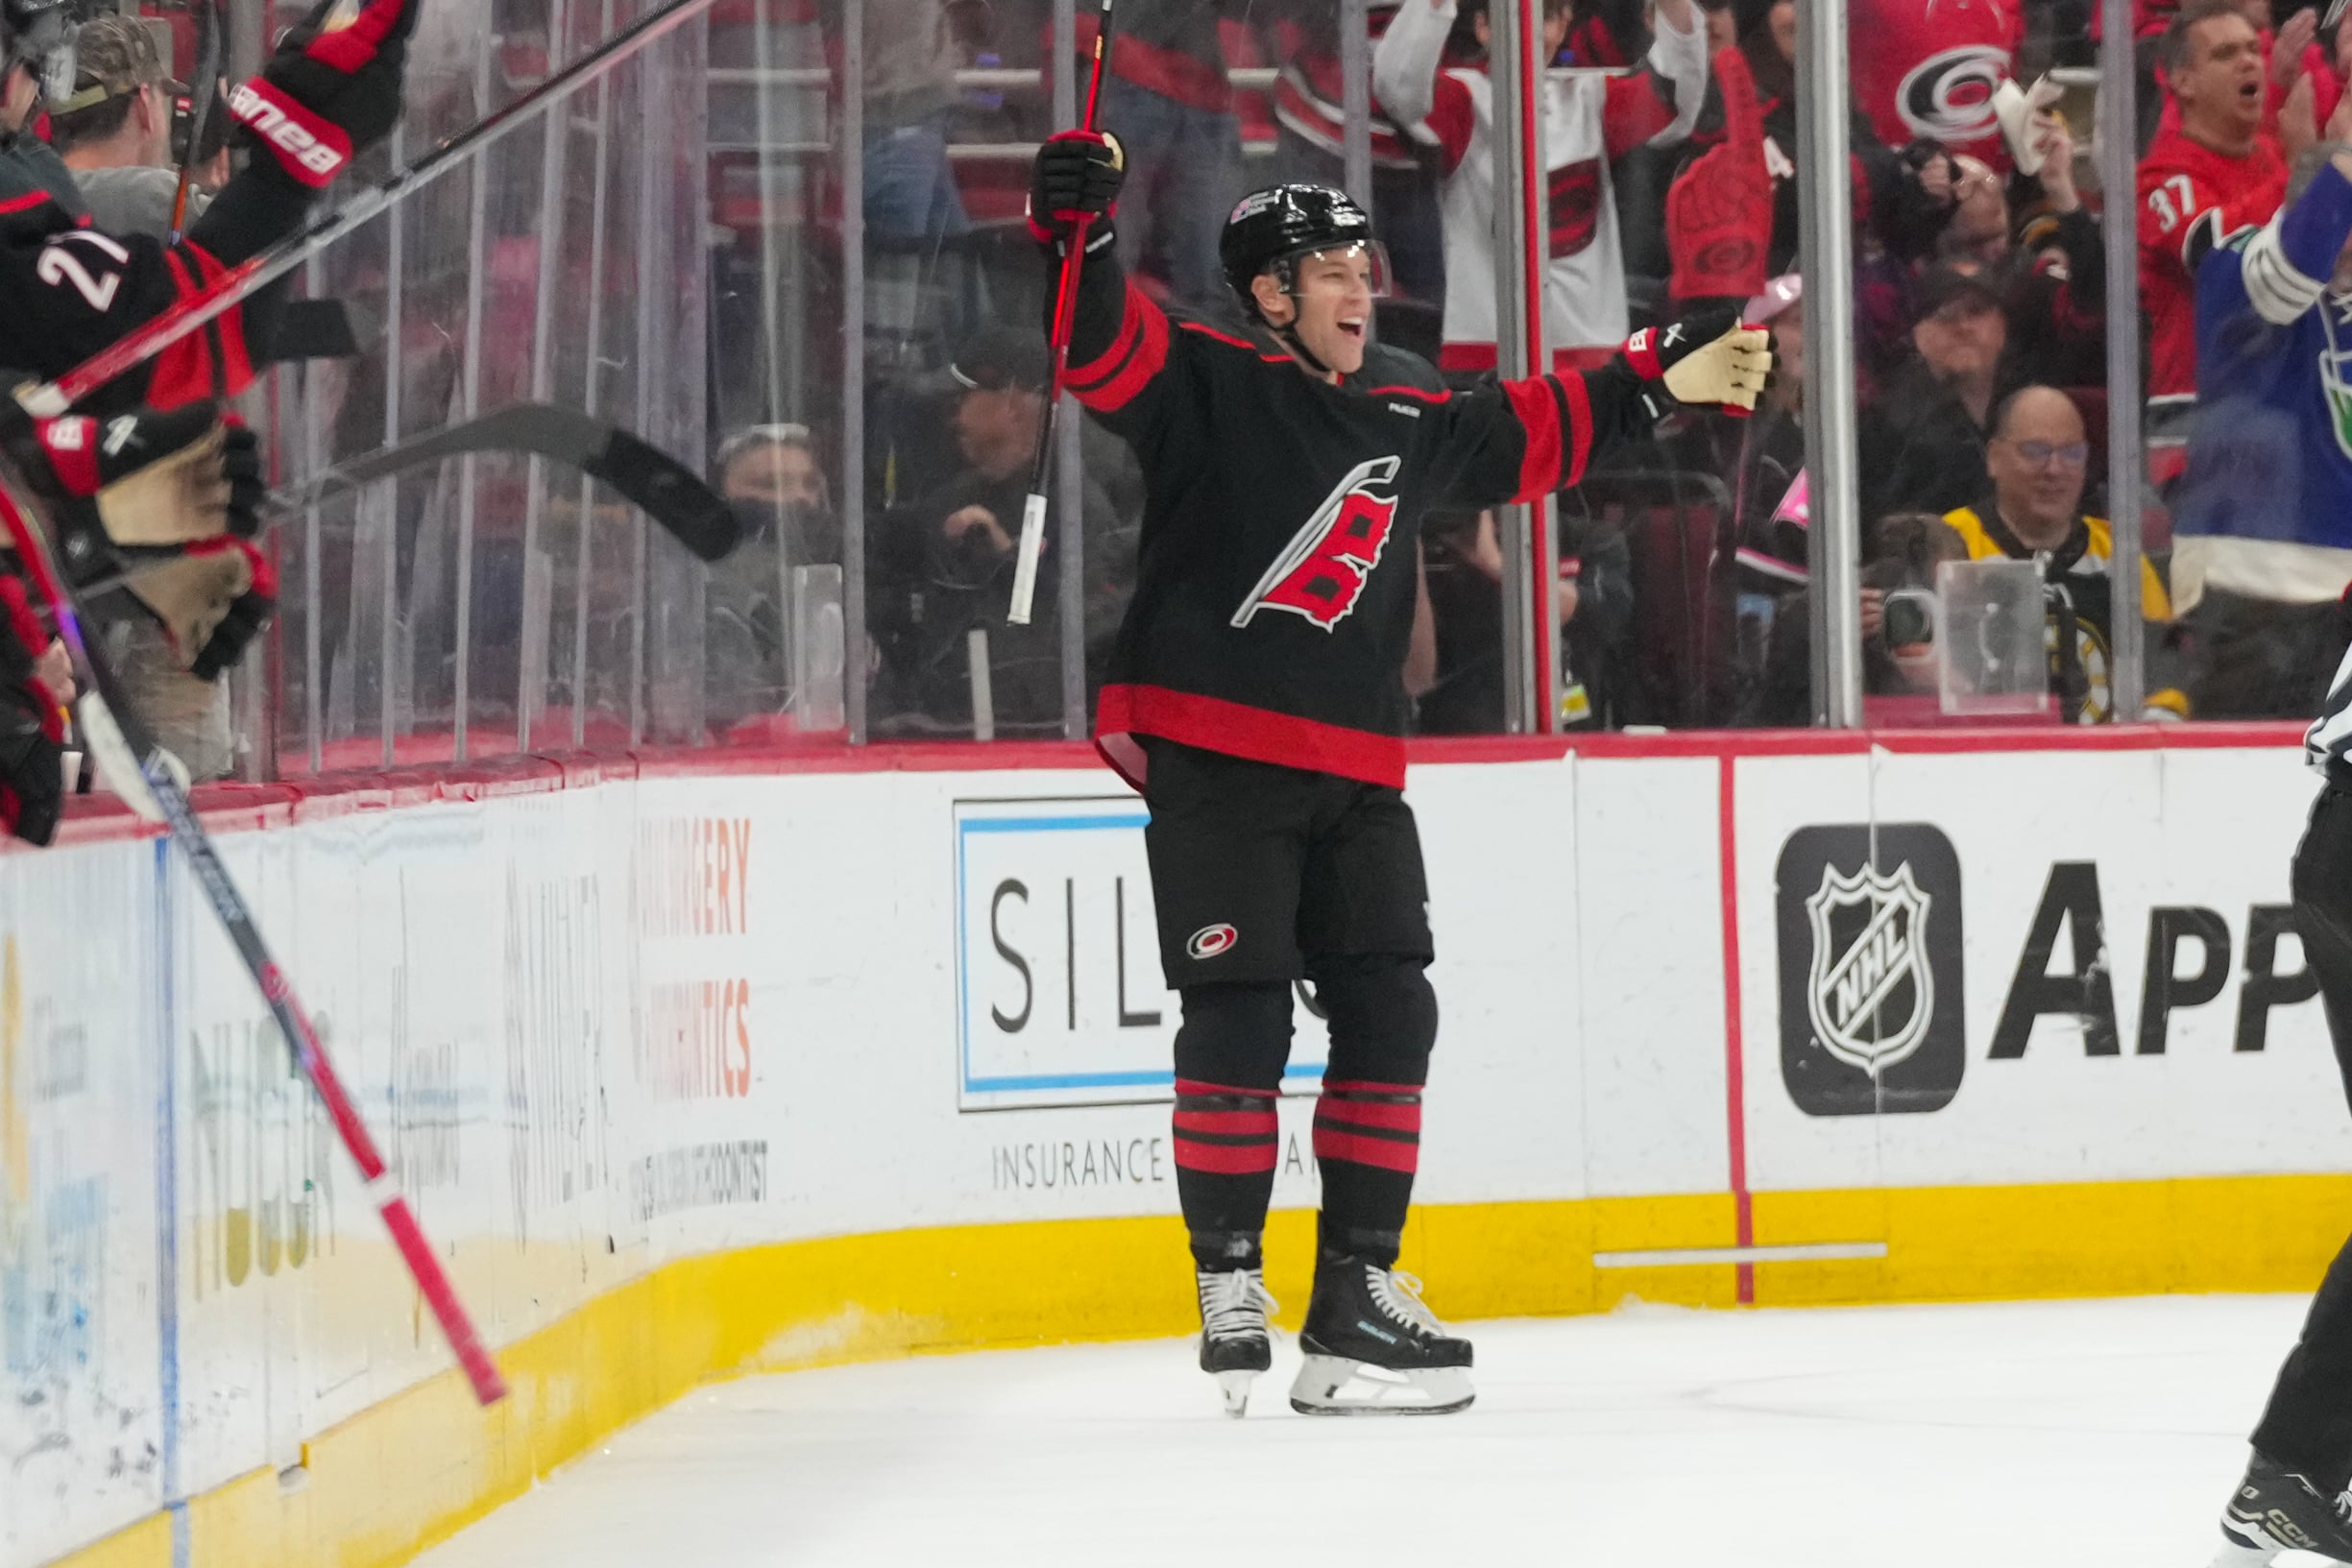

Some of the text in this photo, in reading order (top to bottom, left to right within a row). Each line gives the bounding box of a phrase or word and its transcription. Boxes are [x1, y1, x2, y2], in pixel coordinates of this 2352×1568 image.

[2148, 174, 2195, 233] 37
[1835, 915, 1908, 1027] NHL
[991, 1137, 1164, 1190] INSURANCE
[2267, 1508, 2319, 1548] CCM
